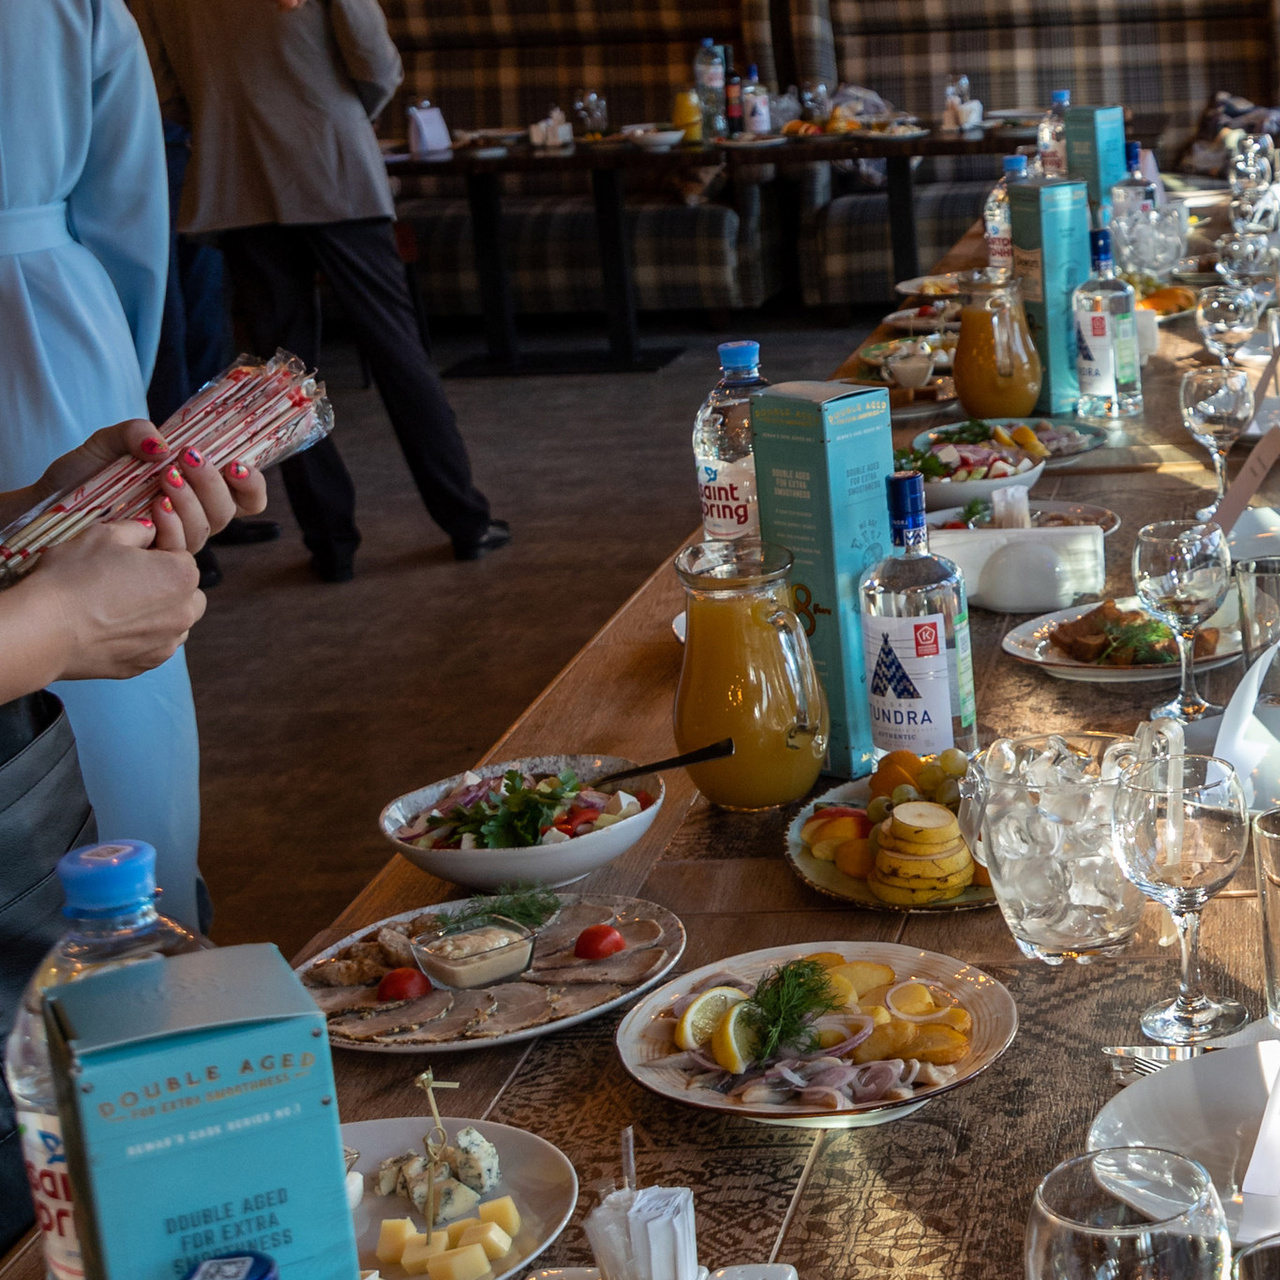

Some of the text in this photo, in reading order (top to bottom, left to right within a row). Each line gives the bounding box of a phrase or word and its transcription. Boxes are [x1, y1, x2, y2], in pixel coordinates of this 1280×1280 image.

[98, 1051, 316, 1118] DOUBLE AGED
[166, 1187, 288, 1235] DOUBLE AGED
[181, 1211, 280, 1252] FOR EXTRA
